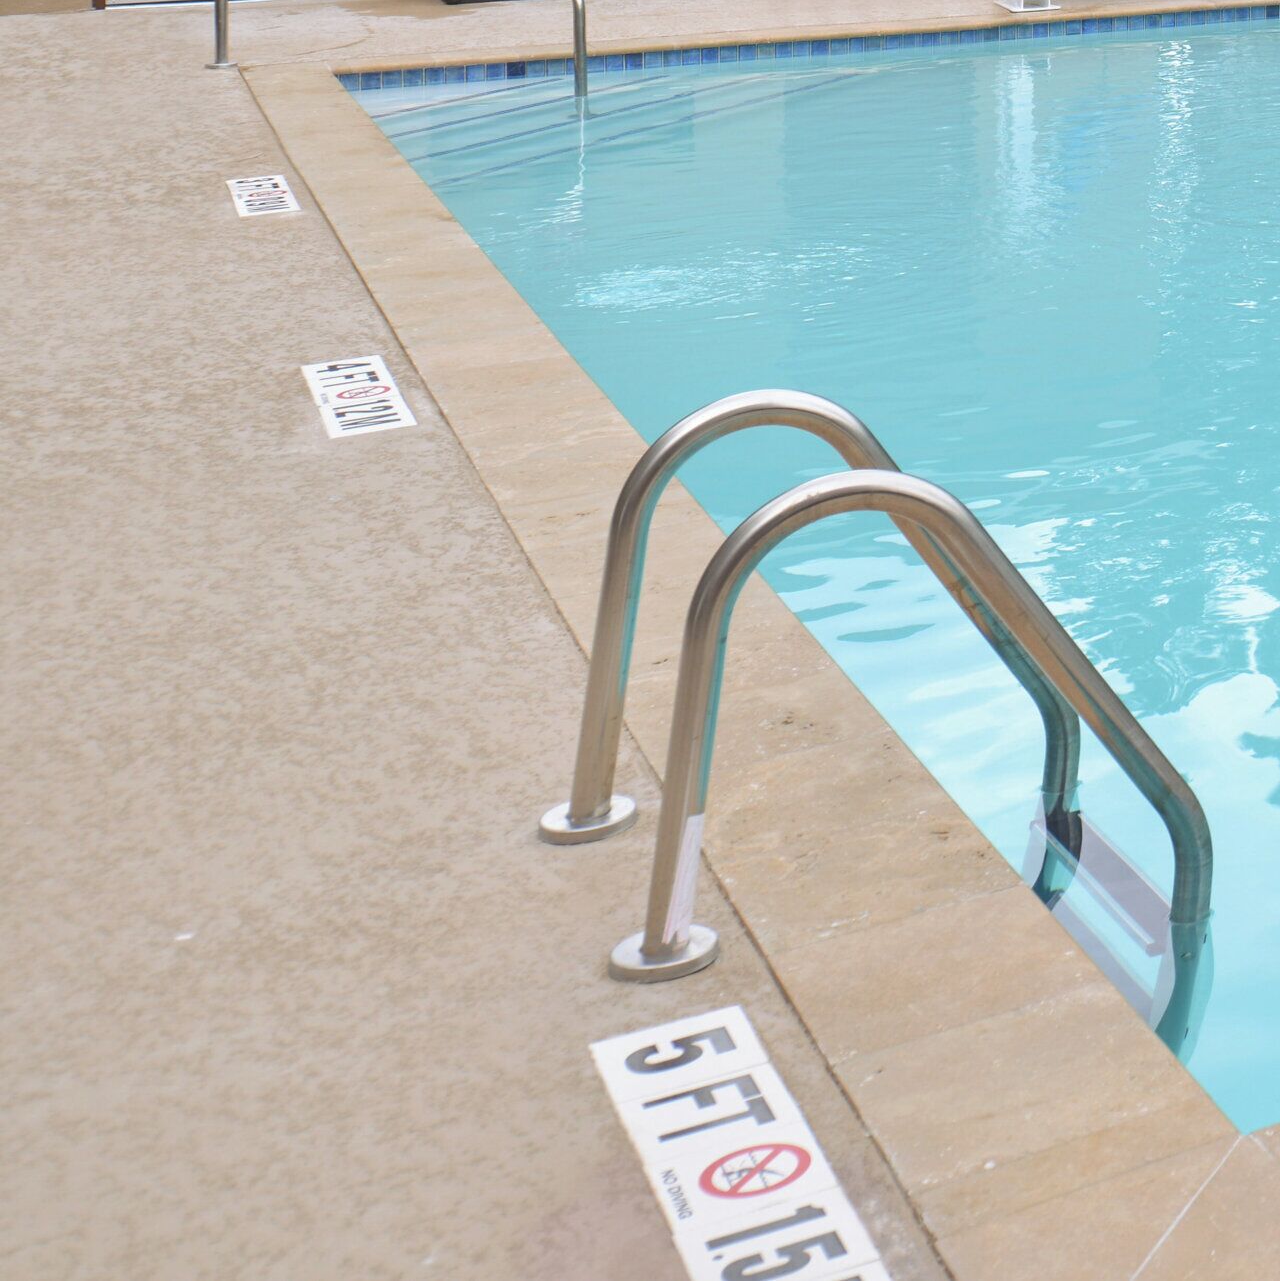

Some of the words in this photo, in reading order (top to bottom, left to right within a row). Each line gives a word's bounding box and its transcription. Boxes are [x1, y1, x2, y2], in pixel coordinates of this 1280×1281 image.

[316, 362, 372, 373] 4
[319, 370, 380, 388] FT
[624, 1026, 738, 1076] 5
[642, 1074, 777, 1144] FT
[660, 1169, 679, 1186] NO
[667, 1185, 694, 1221] DIVING
